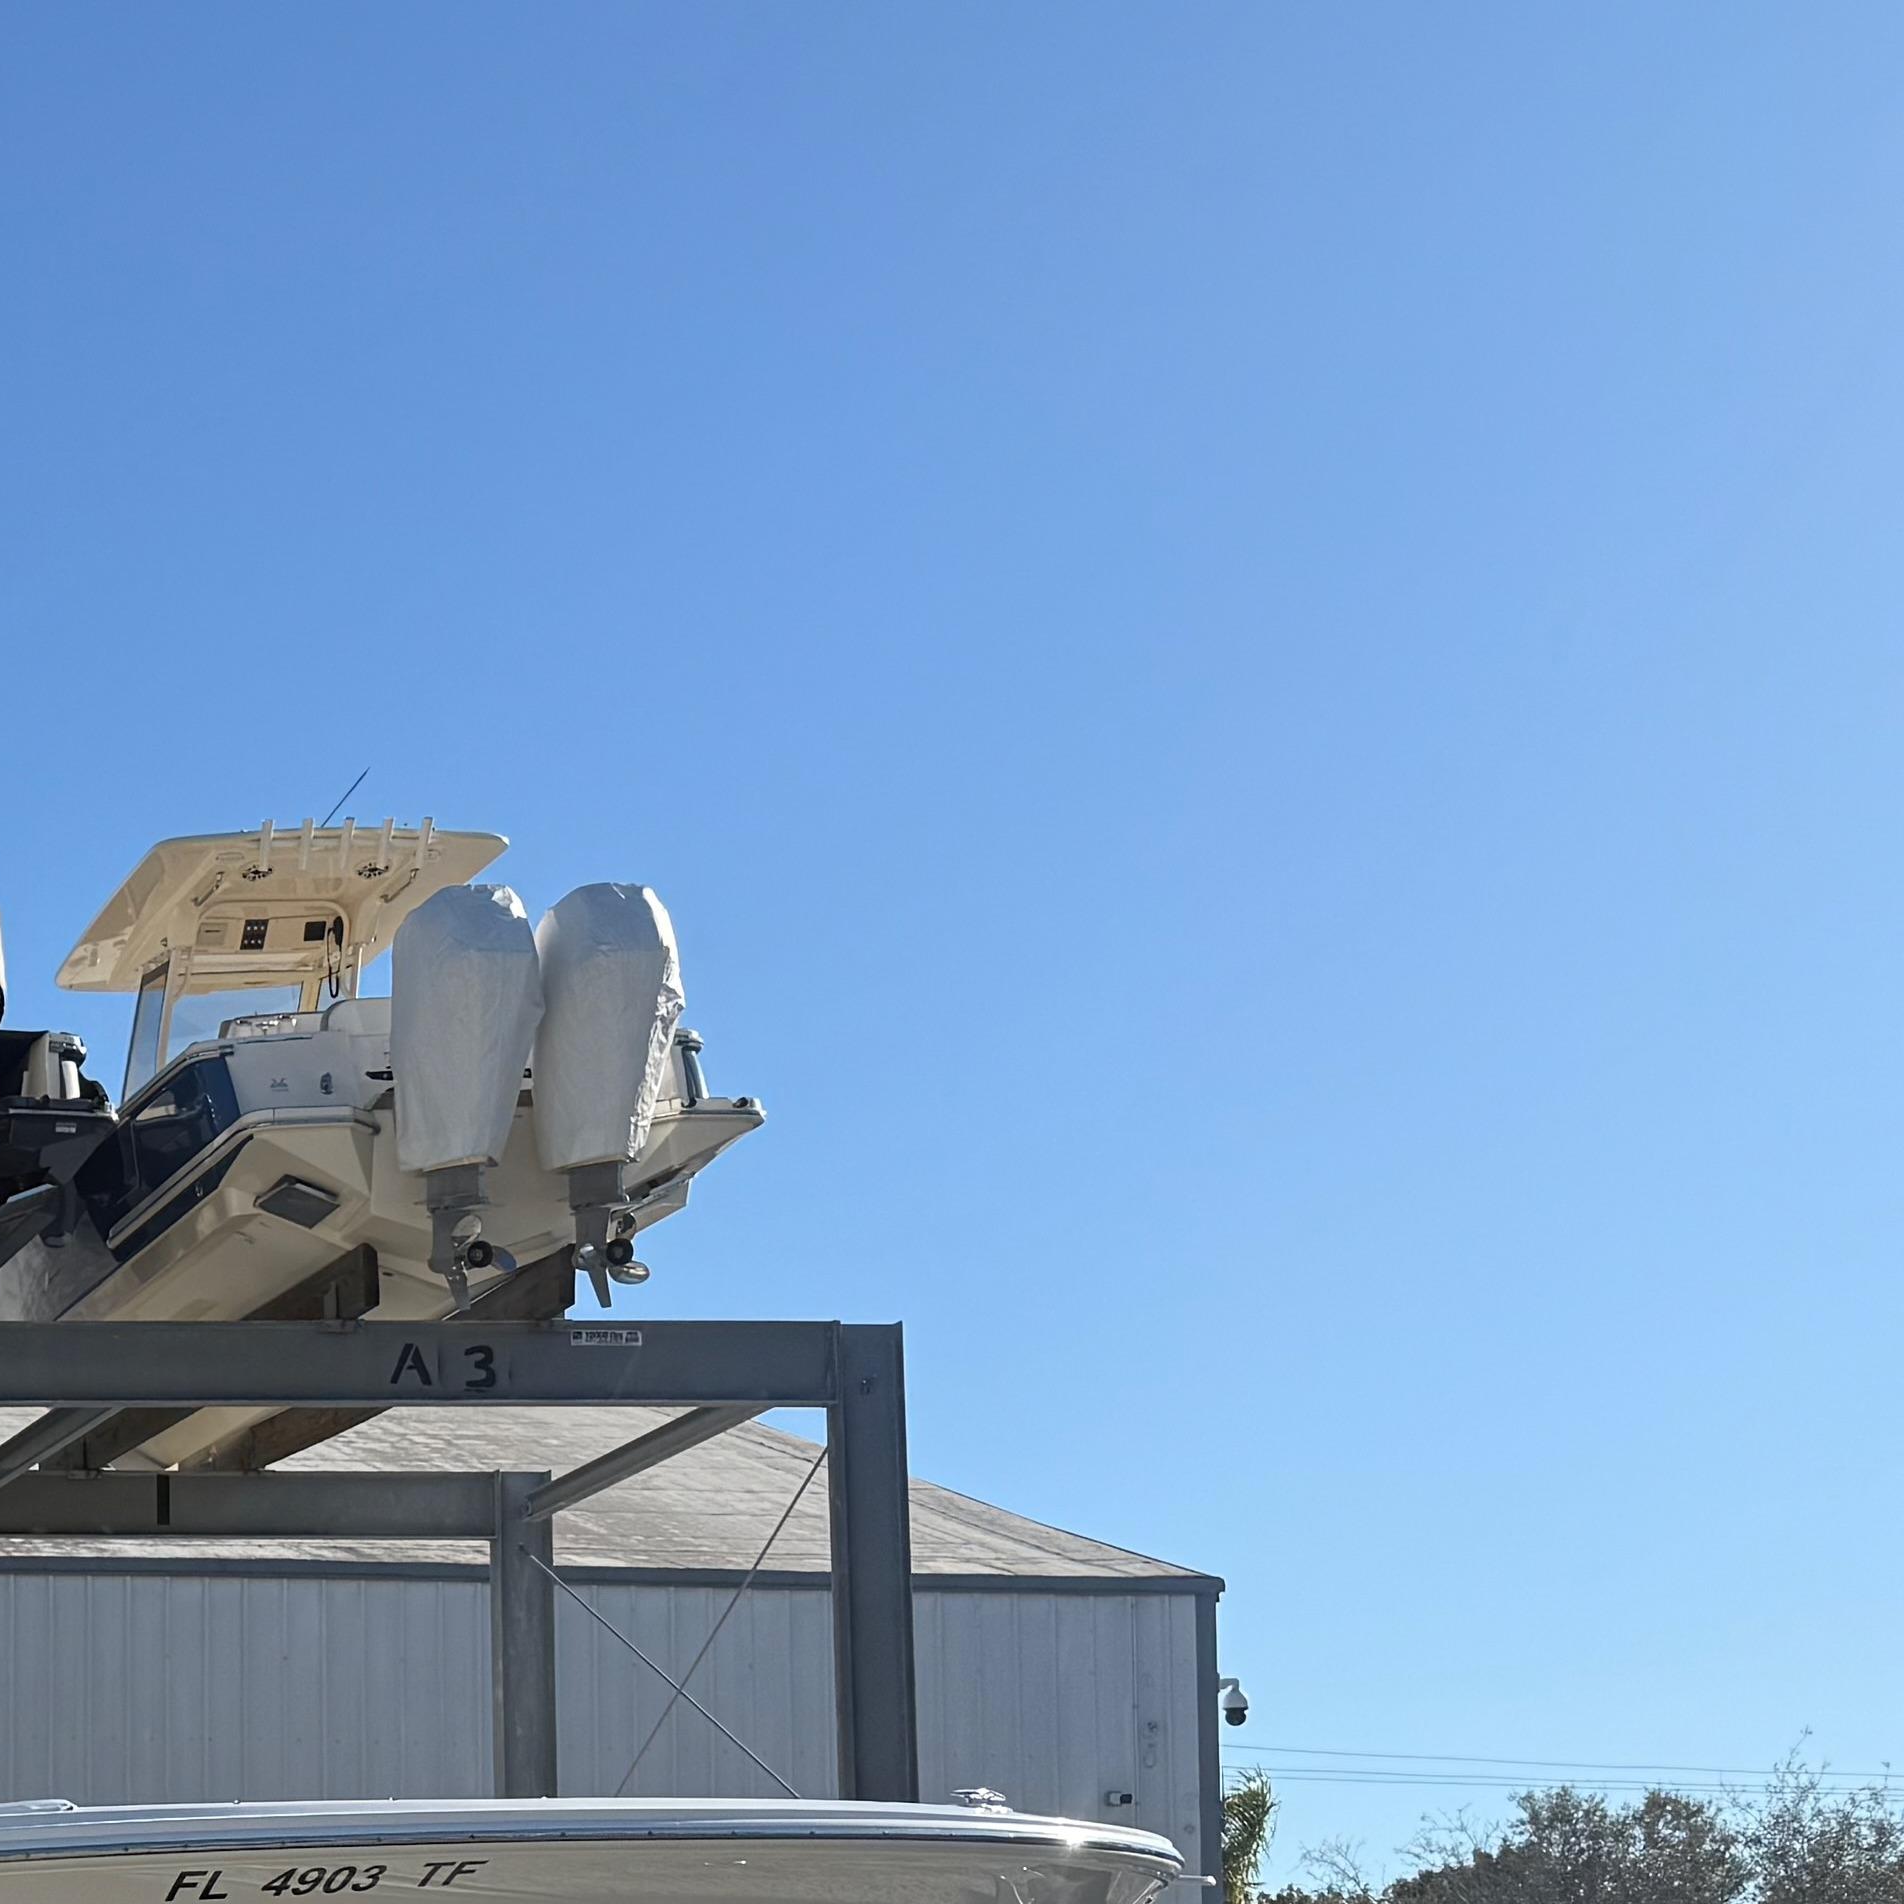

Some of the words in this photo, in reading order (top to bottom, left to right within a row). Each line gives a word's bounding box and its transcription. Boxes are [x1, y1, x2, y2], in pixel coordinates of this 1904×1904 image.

[390, 1342, 432, 1386] A
[464, 1344, 496, 1388] 3
[165, 1869, 229, 1901] FL
[261, 1864, 388, 1897] 4903
[417, 1859, 490, 1888] TF
